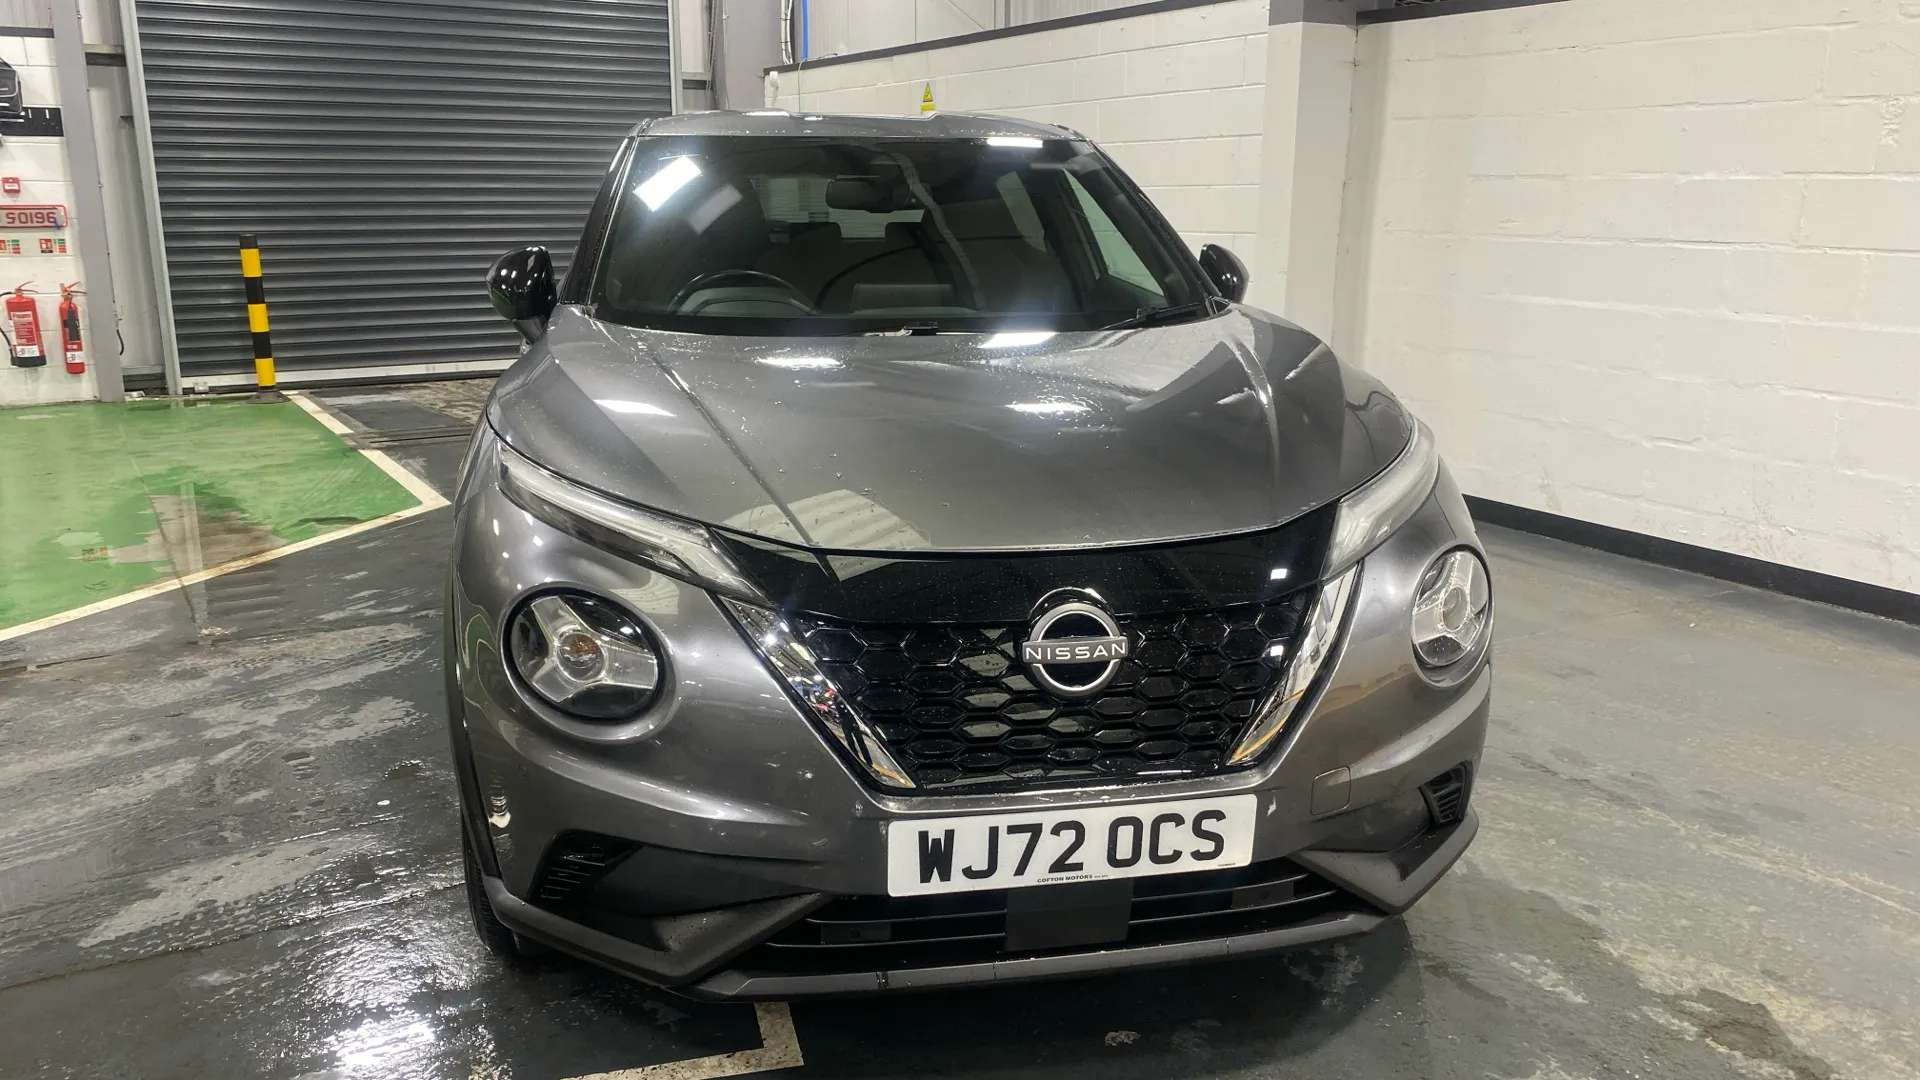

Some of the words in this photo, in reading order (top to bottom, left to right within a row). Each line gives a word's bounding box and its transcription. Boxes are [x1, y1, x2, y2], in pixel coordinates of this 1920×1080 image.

[1025, 642, 1127, 660] NISSAN
[918, 820, 1086, 884] WJ72
[1106, 809, 1227, 869] OCS
